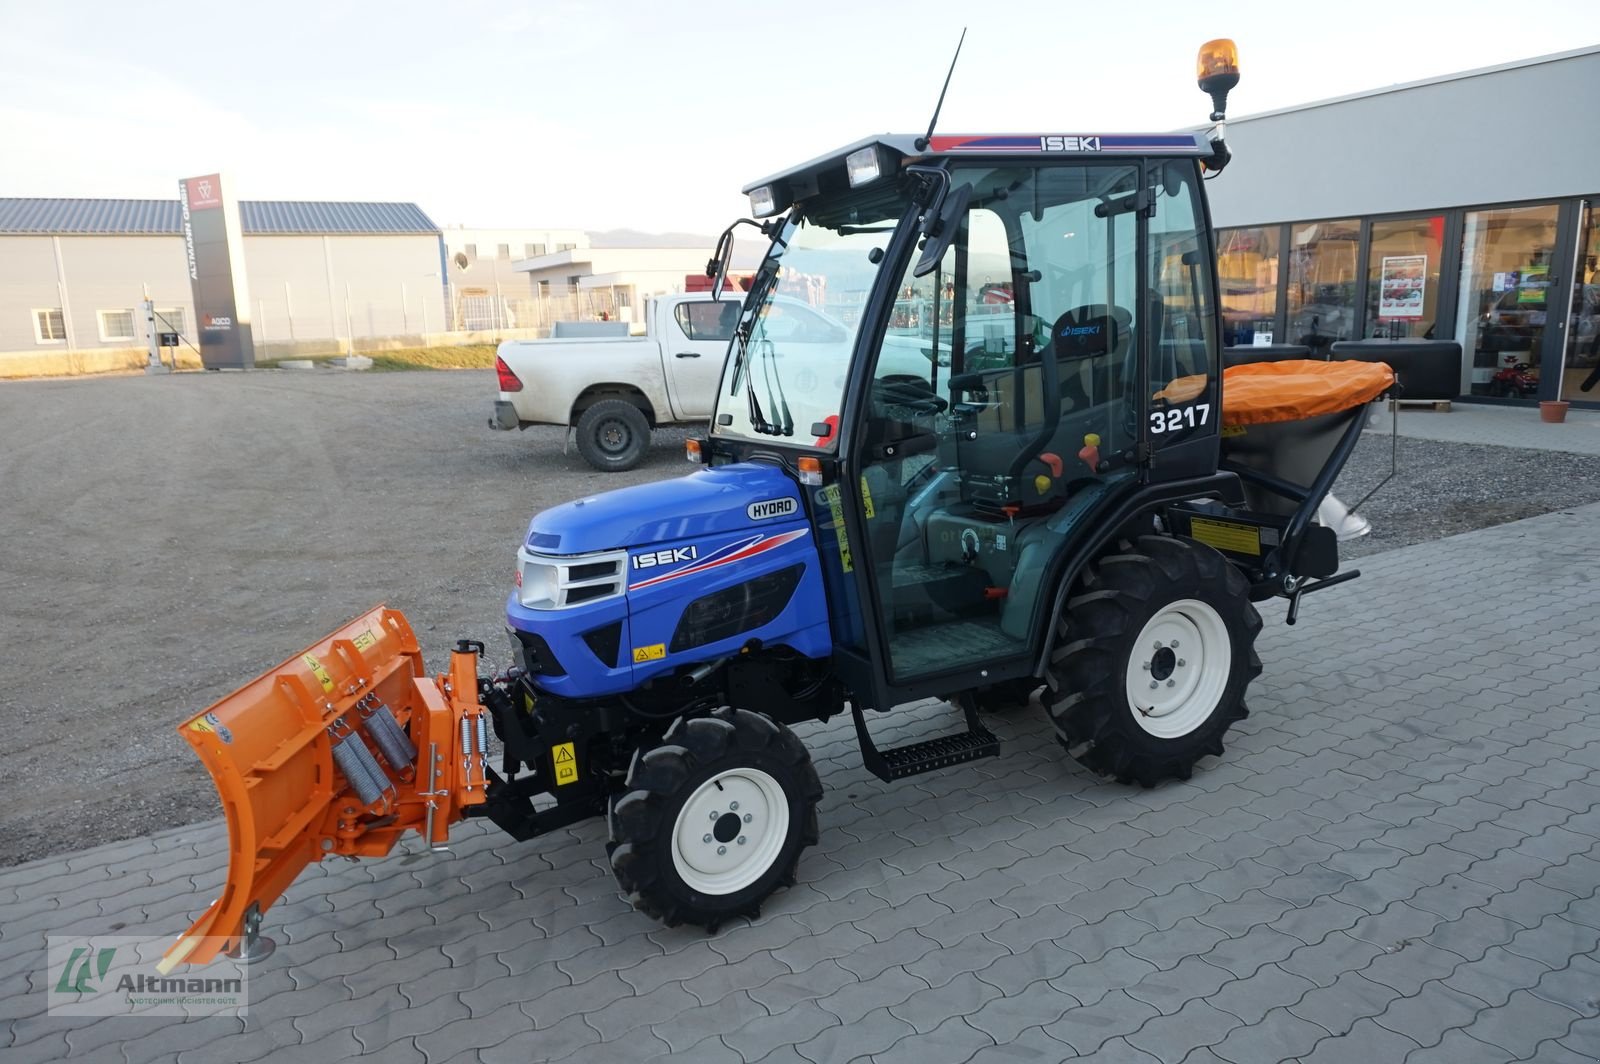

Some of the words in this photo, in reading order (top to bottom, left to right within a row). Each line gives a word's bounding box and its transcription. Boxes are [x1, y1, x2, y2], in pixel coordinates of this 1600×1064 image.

[1041, 136, 1101, 152] ISEKI
[184, 223, 197, 280] ALTMANN
[212, 317, 231, 325] AGCO
[1071, 325, 1100, 336] ISEKI
[1150, 404, 1210, 434] 3217
[753, 499, 792, 518] HYDRO
[632, 545, 698, 570] ISEKI
